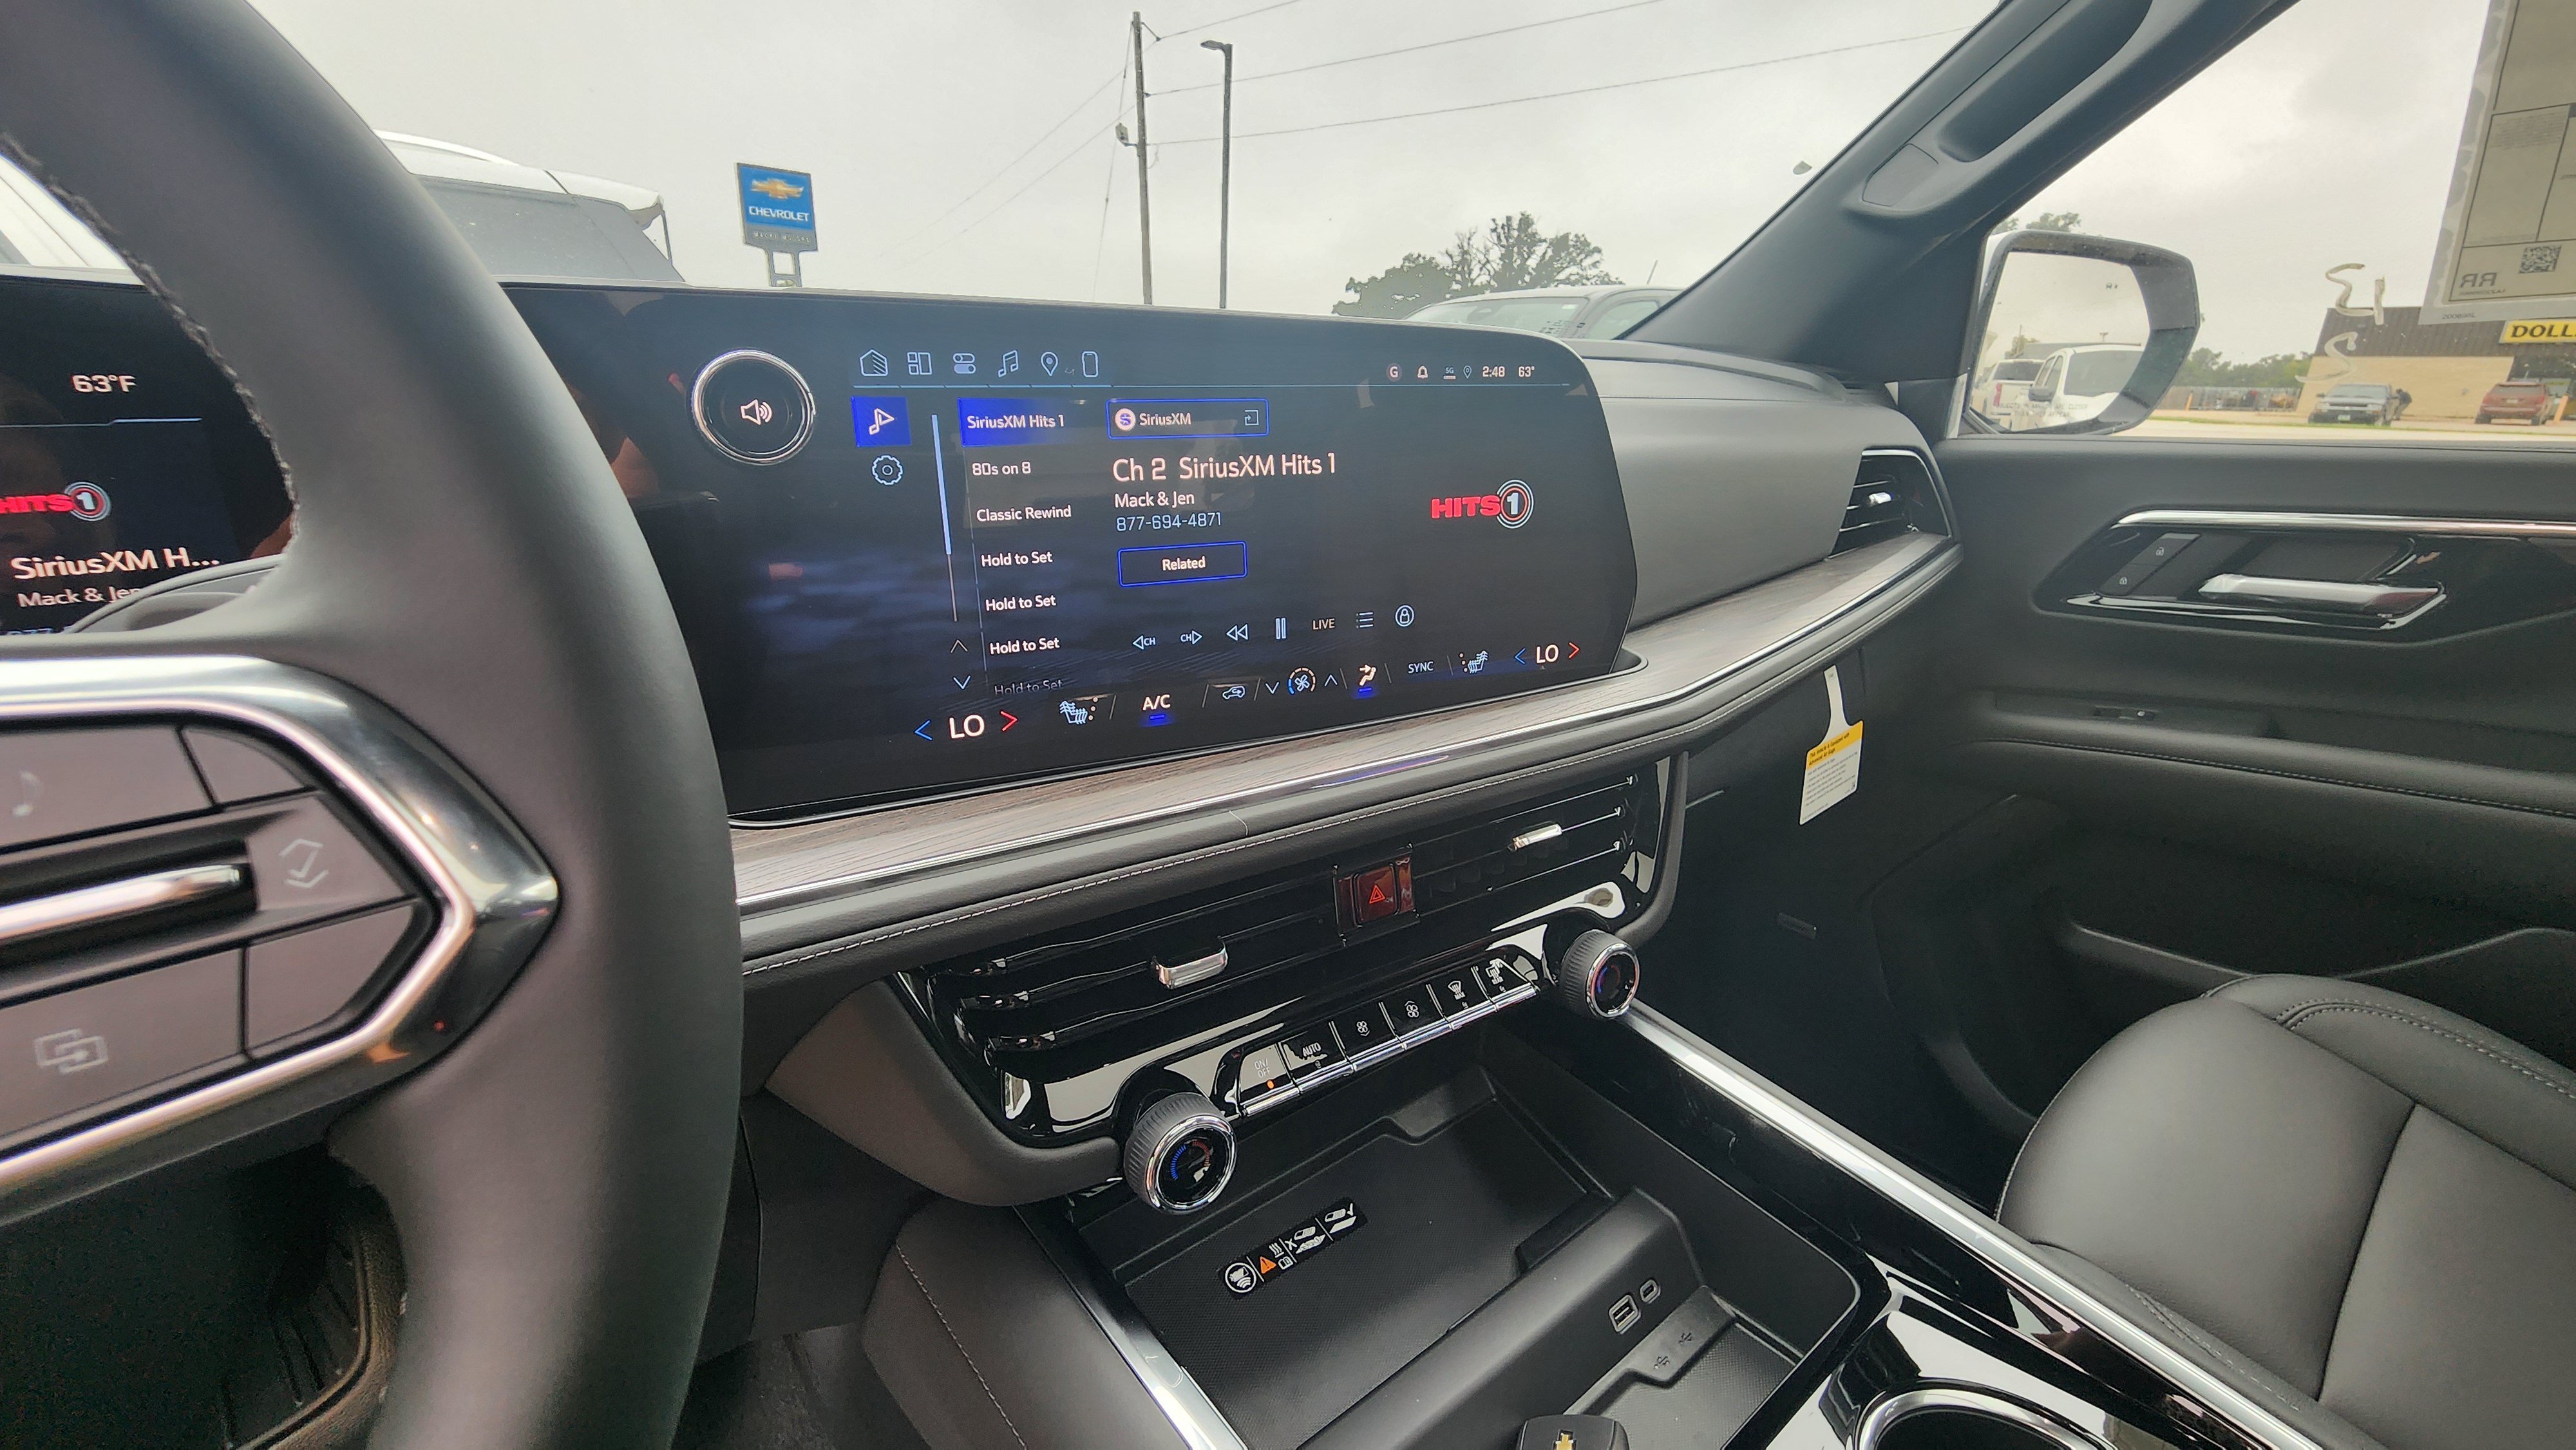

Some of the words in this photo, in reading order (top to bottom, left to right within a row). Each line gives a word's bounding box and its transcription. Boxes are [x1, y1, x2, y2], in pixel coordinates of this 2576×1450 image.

[749, 206, 810, 221] CHEVROLET
[2510, 325, 2576, 338] DOLL
[1482, 366, 1506, 377] 2:48
[1518, 366, 1535, 377] 63°
[71, 374, 137, 393] 63°F
[967, 415, 1026, 429] SiriusXM
[1029, 415, 1056, 428] Hits
[1058, 414, 1065, 427] 1
[1139, 412, 1191, 426] SiriusXM
[972, 462, 999, 475] 80s
[1001, 464, 1018, 475] on
[1021, 461, 1031, 474] 8
[1113, 457, 1144, 482] Ch
[1151, 457, 1166, 480] 2
[1179, 455, 1274, 480] SiriusXM
[1281, 453, 1322, 475] Hits
[1327, 452, 1336, 473] 1
[1114, 492, 1154, 508] Mack
[1157, 491, 1170, 506] &
[1171, 491, 1195, 507] Jen
[1431, 494, 1501, 519] HITS
[976, 507, 1022, 522] Classic
[1025, 505, 1072, 520] Rewind
[1116, 512, 1222, 531] 877-694-4871
[10, 549, 158, 579] SiriusXM
[981, 554, 1012, 567] Hold
[1014, 554, 1028, 565] to
[1031, 552, 1053, 564] Set
[1162, 556, 1206, 571] Related
[17, 588, 82, 607] Mack
[84, 587, 106, 603] &
[985, 598, 1016, 611] Hold
[1018, 597, 1032, 608] to
[1035, 596, 1056, 607] Set
[1312, 618, 1336, 630] LIVE
[1144, 637, 1156, 646] CH
[1180, 634, 1191, 642] CH
[990, 641, 1020, 655] Hold
[1022, 640, 1036, 652] to
[1038, 638, 1060, 650] Set
[1535, 645, 1559, 664] LO
[1408, 660, 1434, 673] SYNC
[994, 683, 1024, 695] Hold
[1043, 680, 1063, 691] Set
[1142, 695, 1171, 711] A/C
[949, 715, 985, 739] LO
[1302, 1042, 1321, 1057] AUTO
[1254, 1058, 1269, 1070] ON/
[1258, 1067, 1271, 1078] OFF
